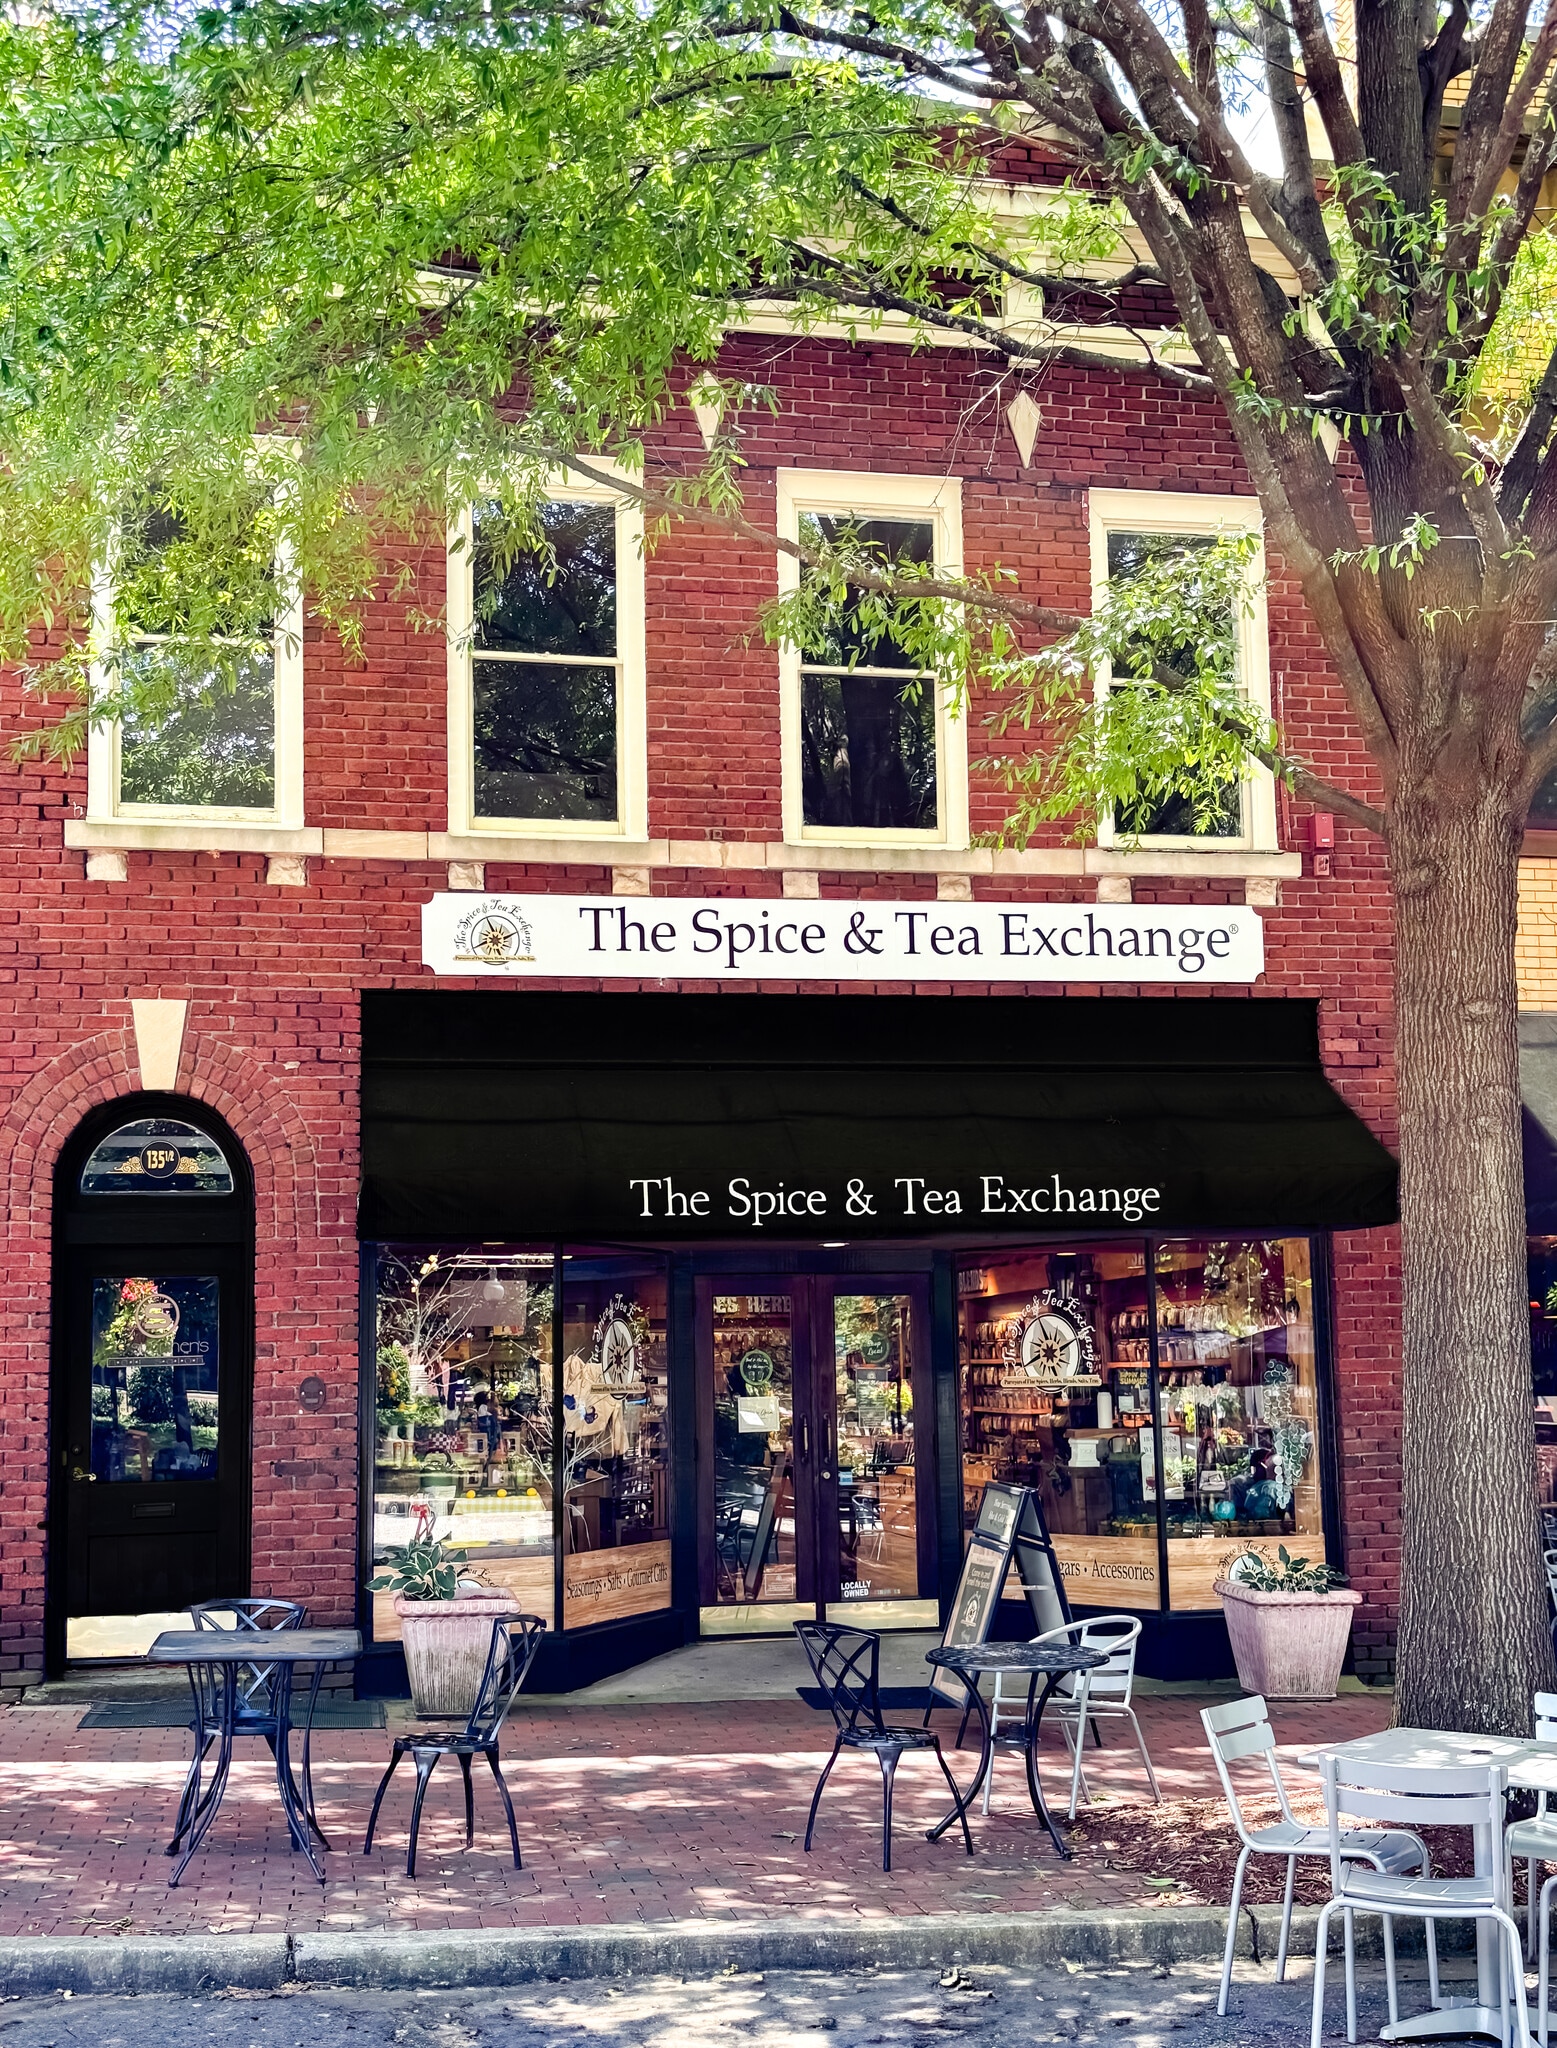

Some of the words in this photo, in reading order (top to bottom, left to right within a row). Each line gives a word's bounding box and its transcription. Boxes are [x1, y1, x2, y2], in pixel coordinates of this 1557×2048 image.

[490, 899, 508, 912] Tea
[457, 907, 481, 930] Spice
[508, 904, 533, 954] Exchange
[453, 930, 467, 950] The
[579, 905, 677, 953] The
[692, 908, 826, 969] Spice
[843, 910, 885, 955] &
[894, 911, 984, 956] Tea
[629, 1176, 710, 1217] The
[727, 1177, 828, 1226] Spice
[845, 1178, 877, 1216] &
[894, 1177, 963, 1215] Tea
[980, 1174, 1162, 1222] Exchange
[614, 1293, 628, 1313] Tea
[1002, 1338, 1016, 1371] The
[1042, 1289, 1064, 1307] Tea
[1063, 1296, 1096, 1374] Exchange
[566, 1578, 602, 1601] Seasonings
[607, 1570, 622, 1592] Salts
[627, 1566, 653, 1588] Gourmet
[653, 1561, 668, 1583] Gifts
[1058, 1560, 1080, 1581] gars
[1091, 1558, 1155, 1581] Accessories
[840, 1580, 872, 1591] LOCALLY
[843, 1588, 869, 1598] OWNED
